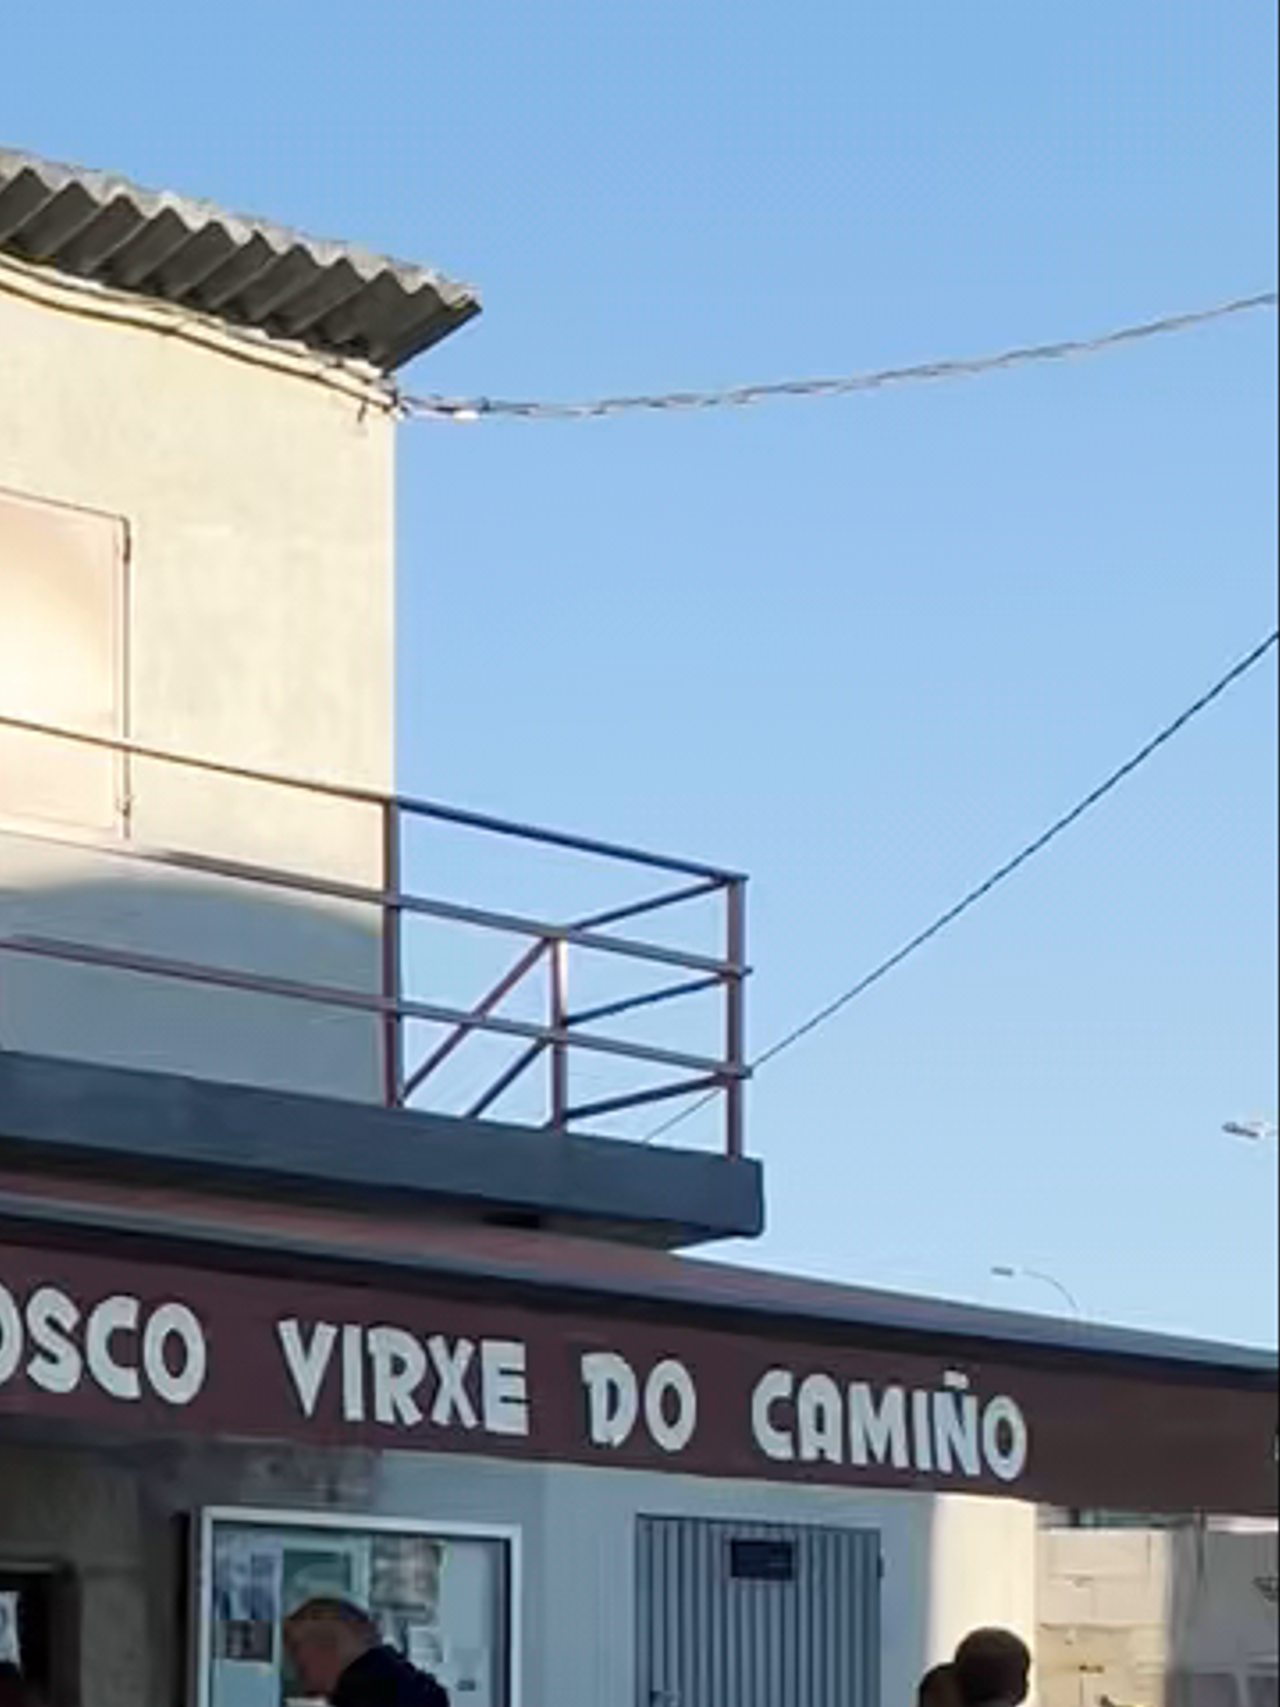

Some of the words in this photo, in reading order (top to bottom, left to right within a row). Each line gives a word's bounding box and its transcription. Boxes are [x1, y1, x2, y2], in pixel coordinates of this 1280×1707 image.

[277, 1317, 530, 1437] VIRXE
[580, 1351, 698, 1452] DO
[751, 1369, 1028, 1481] CAMIÑO
